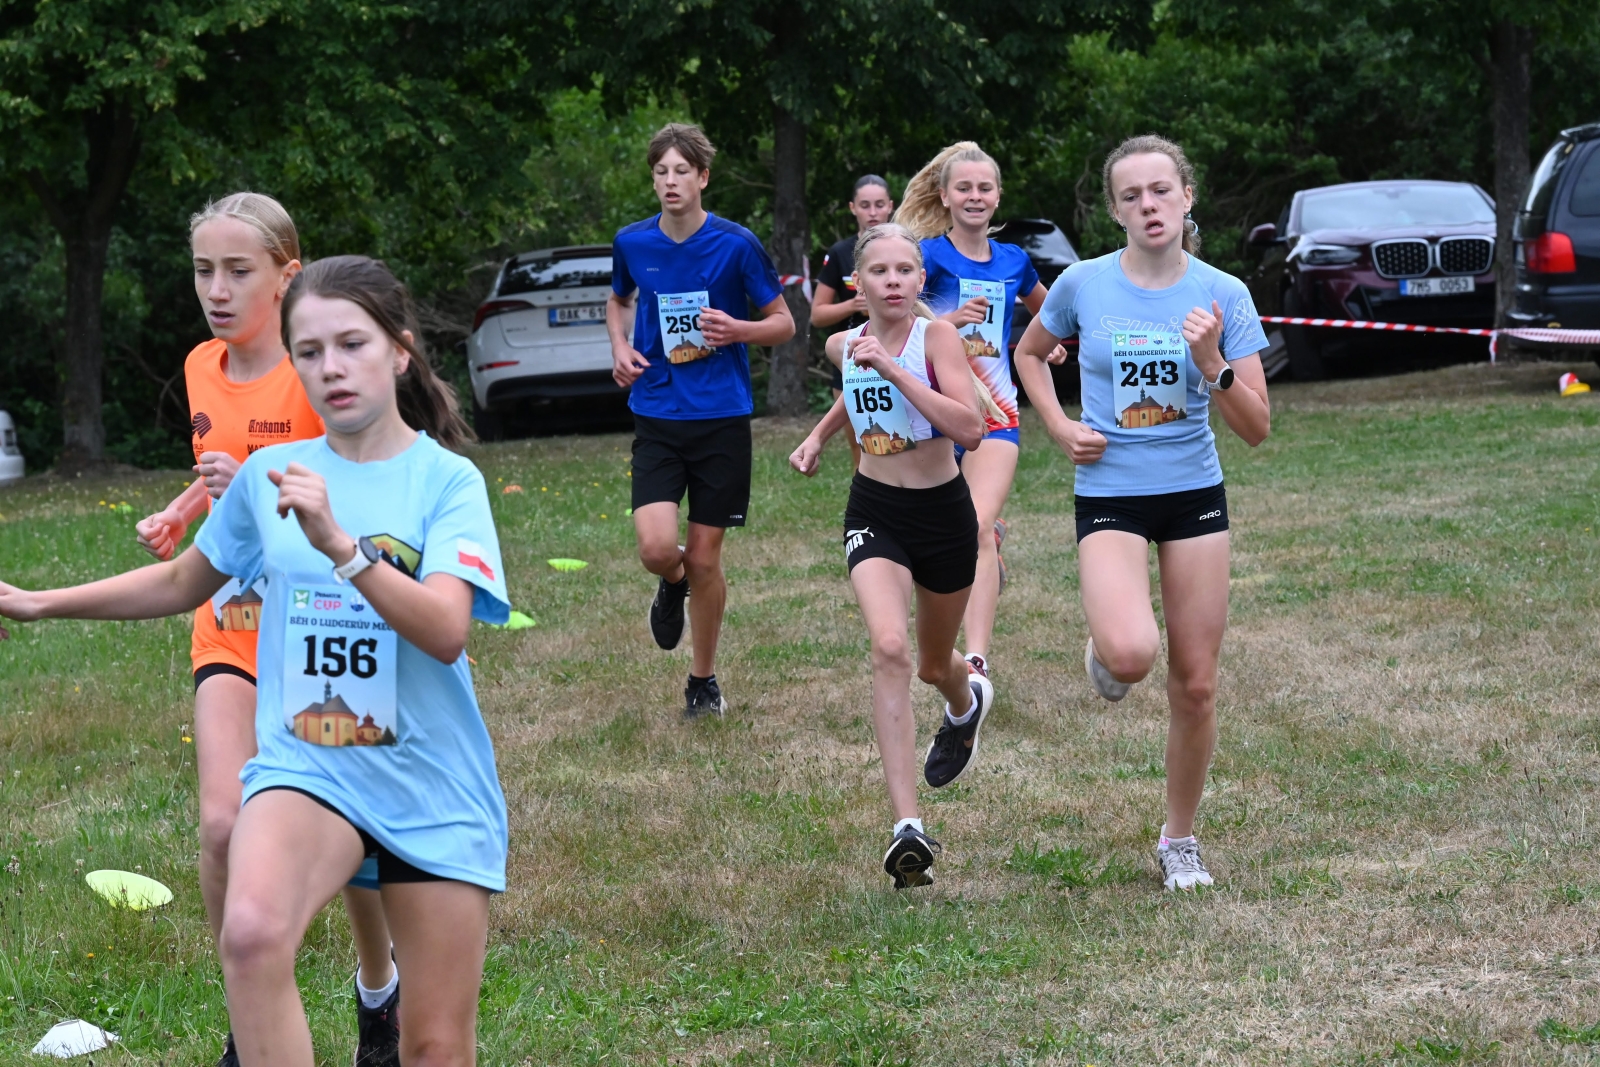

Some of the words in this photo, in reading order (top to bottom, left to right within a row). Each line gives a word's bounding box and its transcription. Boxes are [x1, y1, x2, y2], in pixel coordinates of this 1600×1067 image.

[1129, 338, 1148, 346] CUP
[1120, 359, 1179, 387] 243
[853, 386, 893, 413] 165
[248, 419, 292, 434] Krakonoš
[1199, 509, 1221, 521] PRO
[314, 599, 342, 611] CUP
[290, 616, 308, 626] BĚH
[311, 618, 317, 626] O
[320, 618, 370, 630] LUDGERŮV
[303, 634, 378, 679] 156
